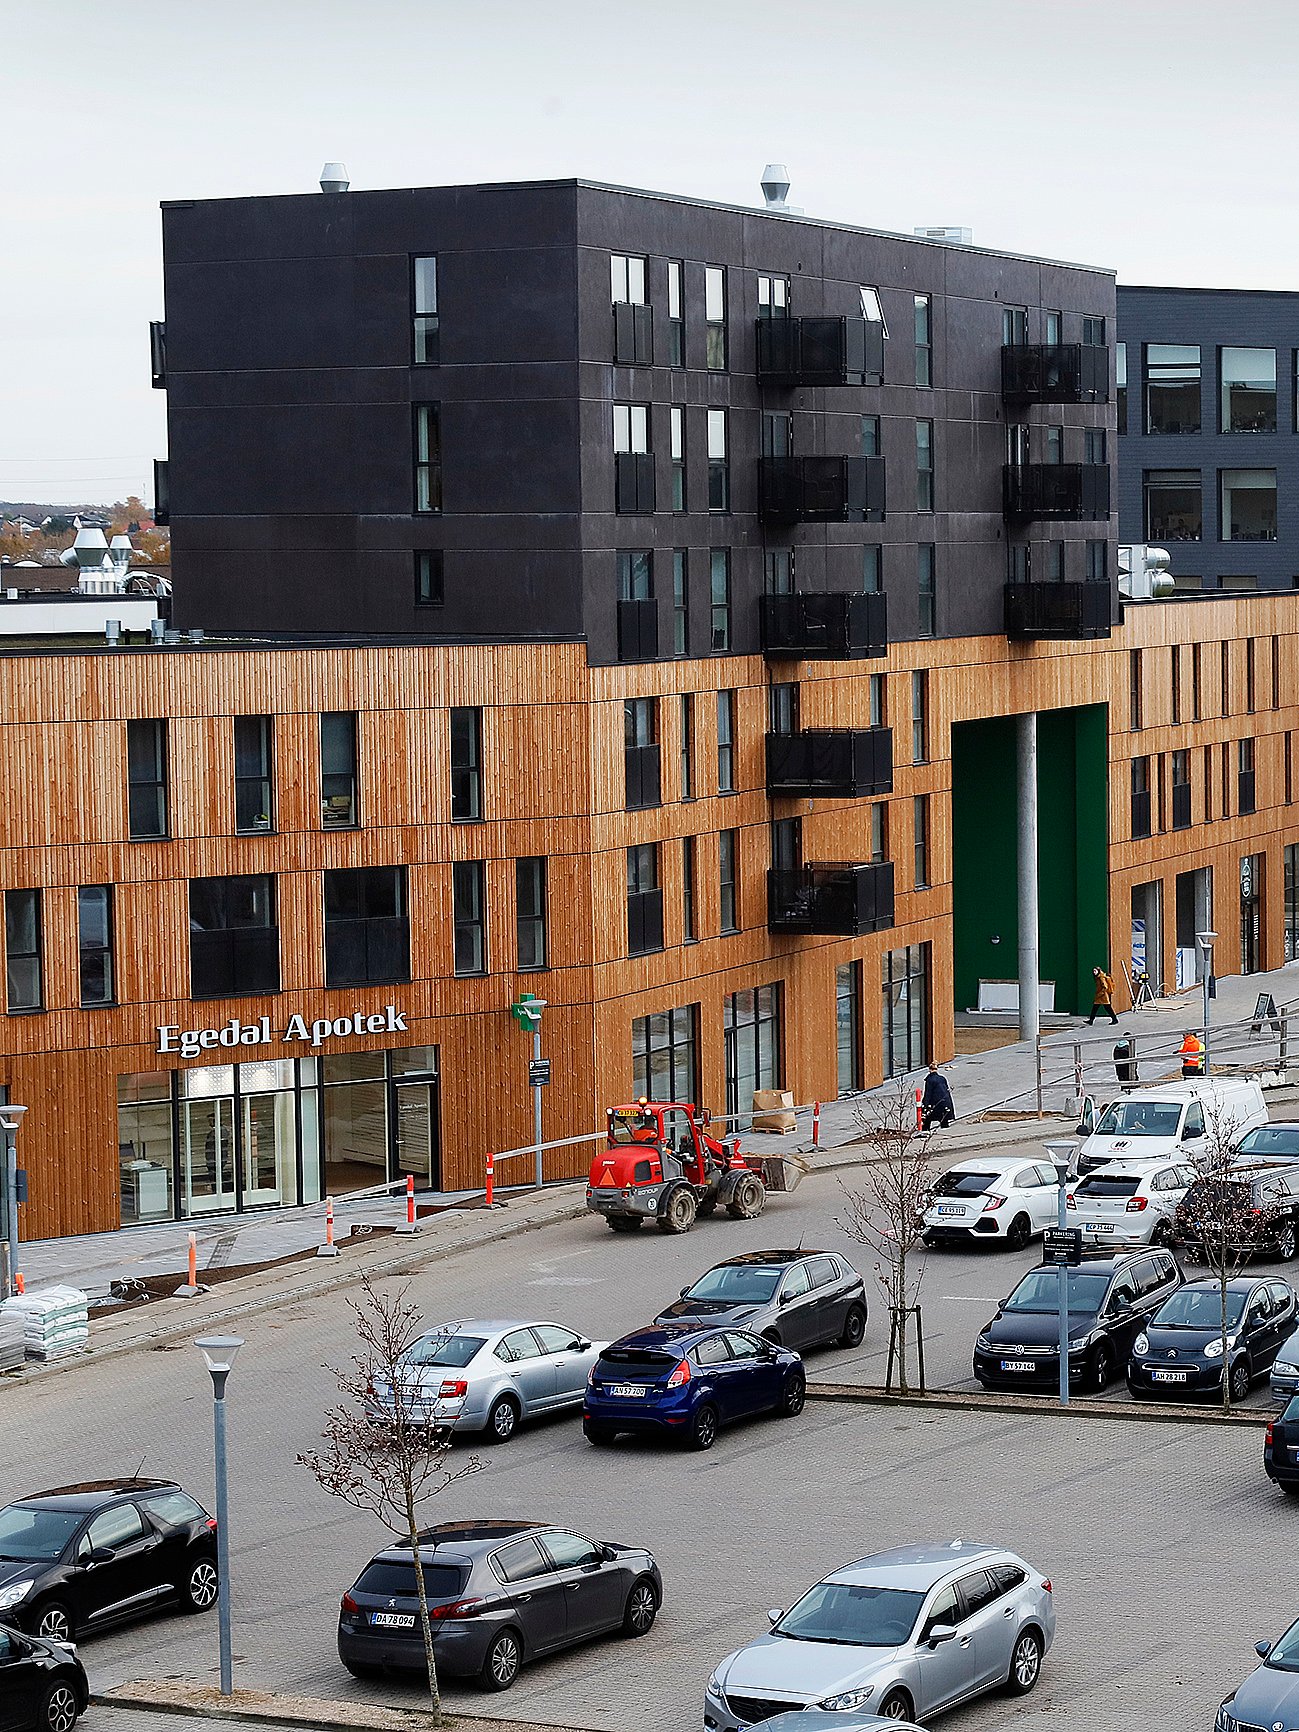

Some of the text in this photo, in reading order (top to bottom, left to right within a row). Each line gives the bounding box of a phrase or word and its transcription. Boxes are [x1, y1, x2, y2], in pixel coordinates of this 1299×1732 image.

[156, 1005, 408, 1059] Egedal Apotek
[1044, 1230, 1050, 1241] P
